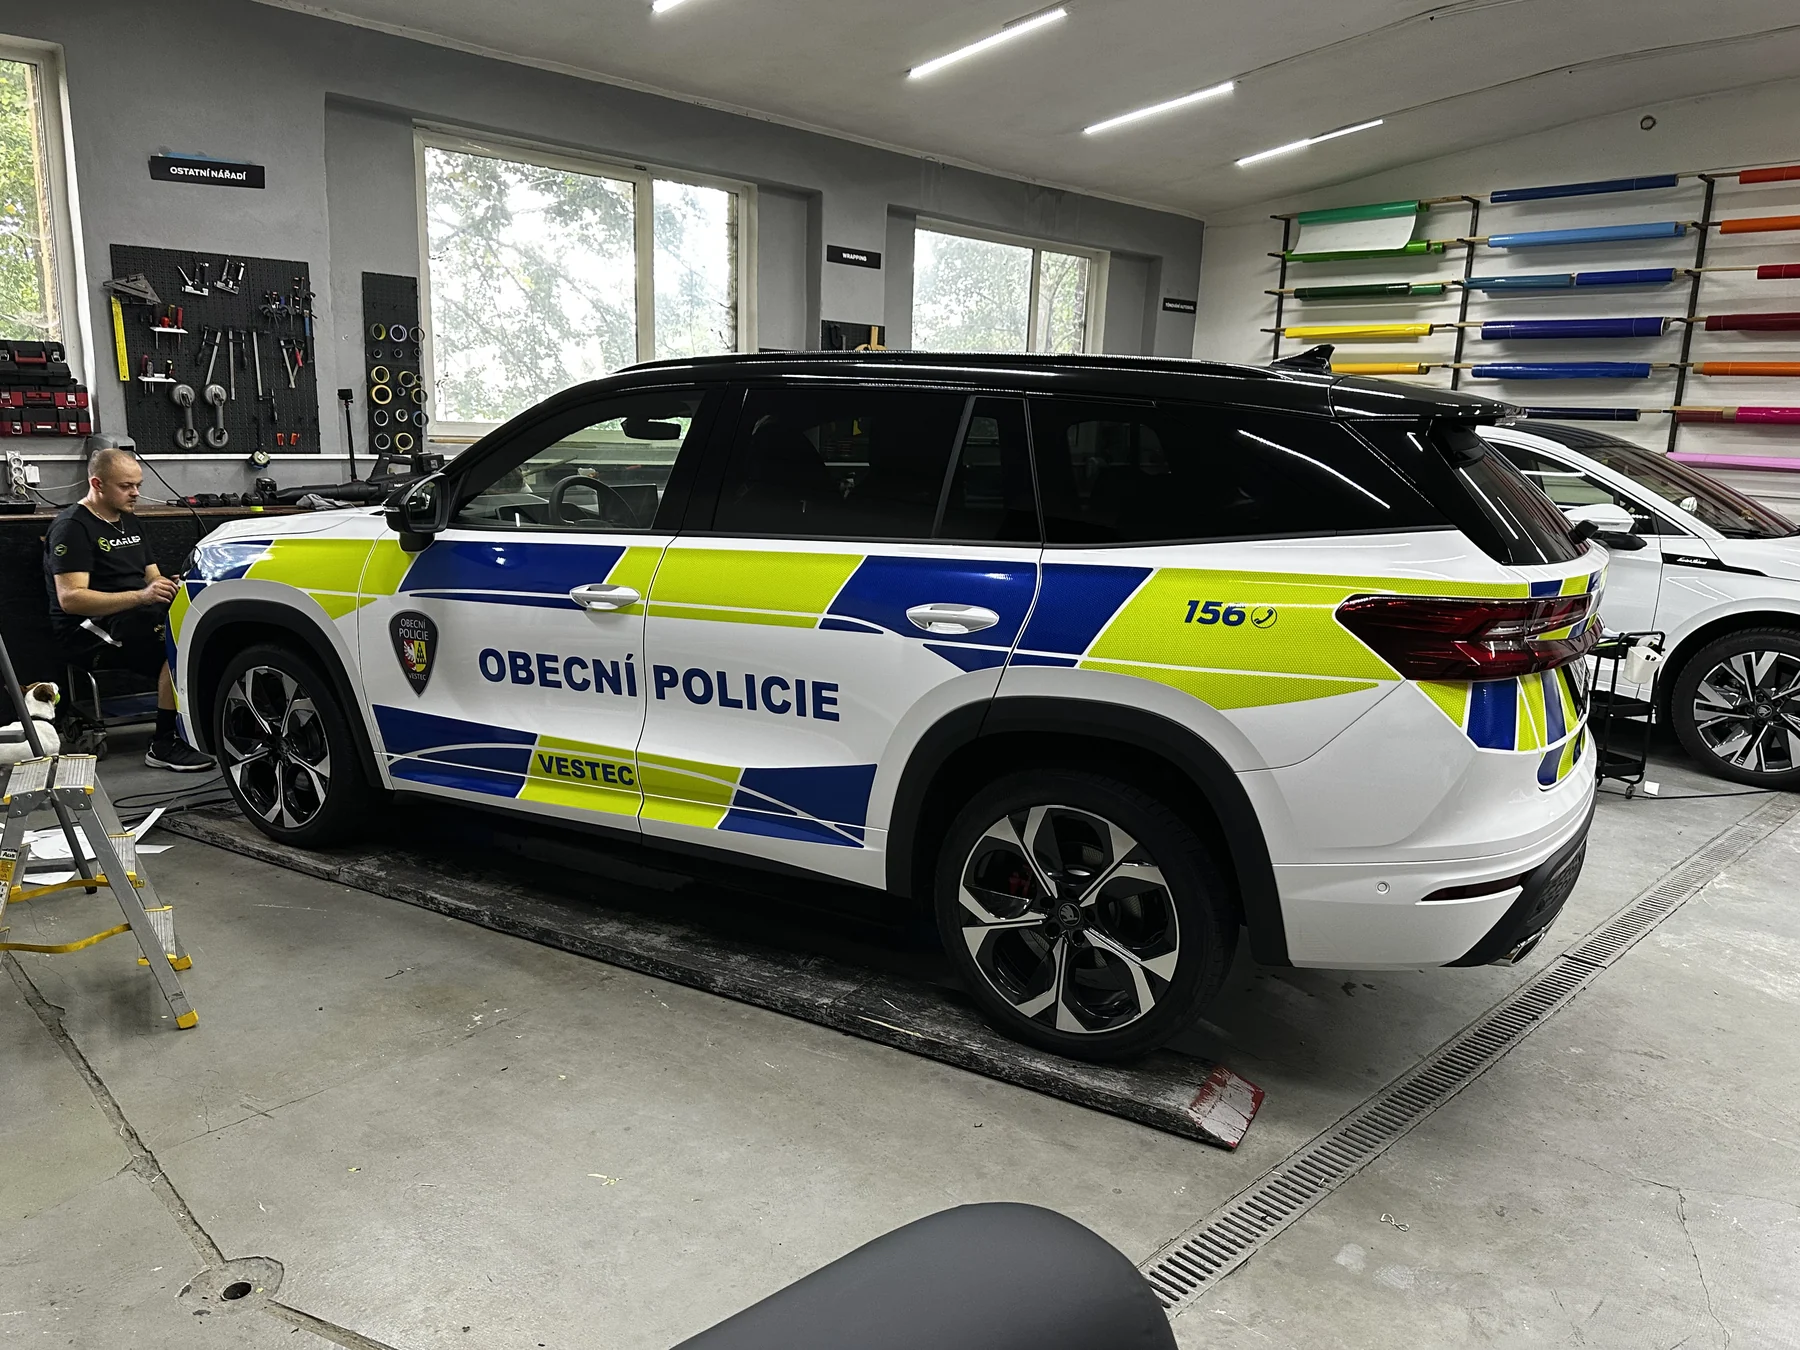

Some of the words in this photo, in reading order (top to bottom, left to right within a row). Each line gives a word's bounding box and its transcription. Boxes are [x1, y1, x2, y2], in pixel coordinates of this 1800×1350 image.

[169, 166, 210, 177] OSTATNÍ
[211, 169, 247, 180] NÁŘADÍ
[842, 252, 867, 261] WRAPPING
[1184, 600, 1246, 626] 156
[400, 618, 426, 628] OBECNÍ
[398, 628, 429, 640] POLICIE
[408, 672, 427, 681] VESTEC
[478, 647, 637, 697] OBECNÍ
[652, 664, 840, 722] POLICIE
[537, 753, 635, 786] VESTEC
